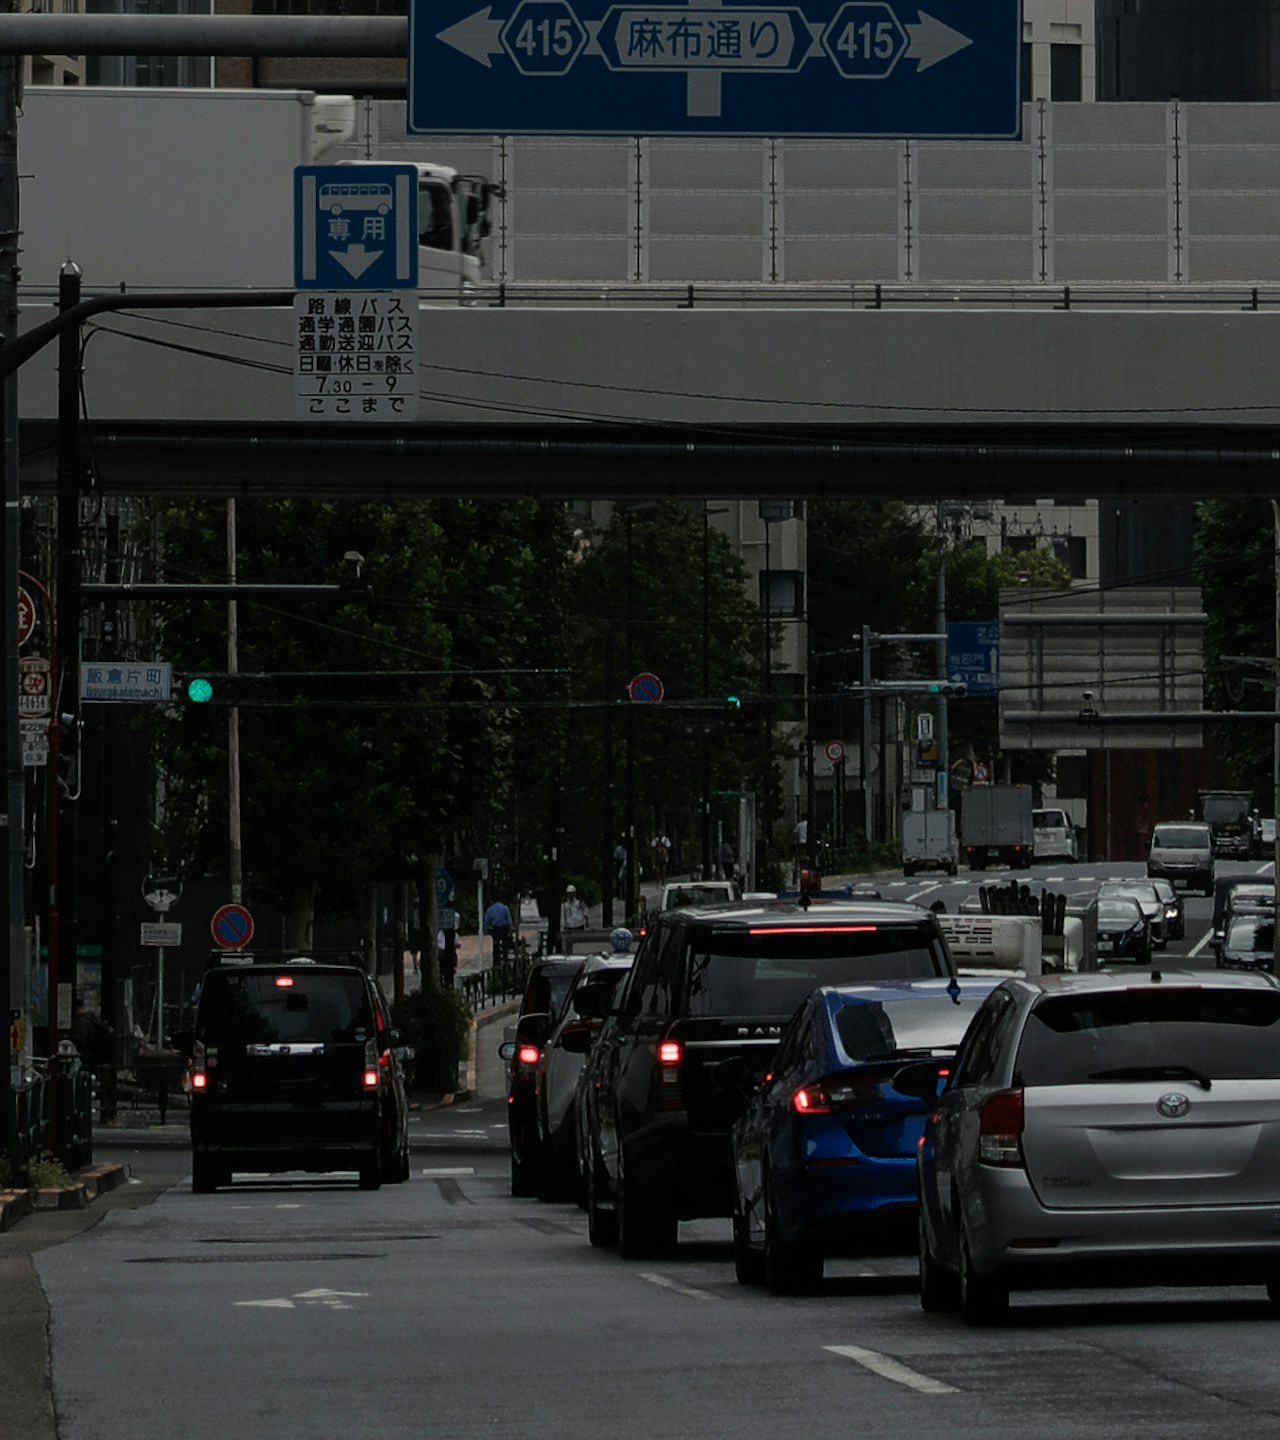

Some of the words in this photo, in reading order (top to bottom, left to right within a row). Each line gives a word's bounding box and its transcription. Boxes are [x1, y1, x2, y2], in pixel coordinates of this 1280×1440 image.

[515, 17, 573, 58] 415
[626, 17, 781, 60] 麻布通り
[836, 21, 895, 61] 415
[327, 217, 386, 242] 専用
[308, 297, 405, 315] 路線バス
[298, 315, 414, 334] 通学通園バス
[298, 334, 414, 352] 通勤送迎バス
[308, 397, 406, 415] ここまで
[86, 666, 162, 685] 飯倉片町
